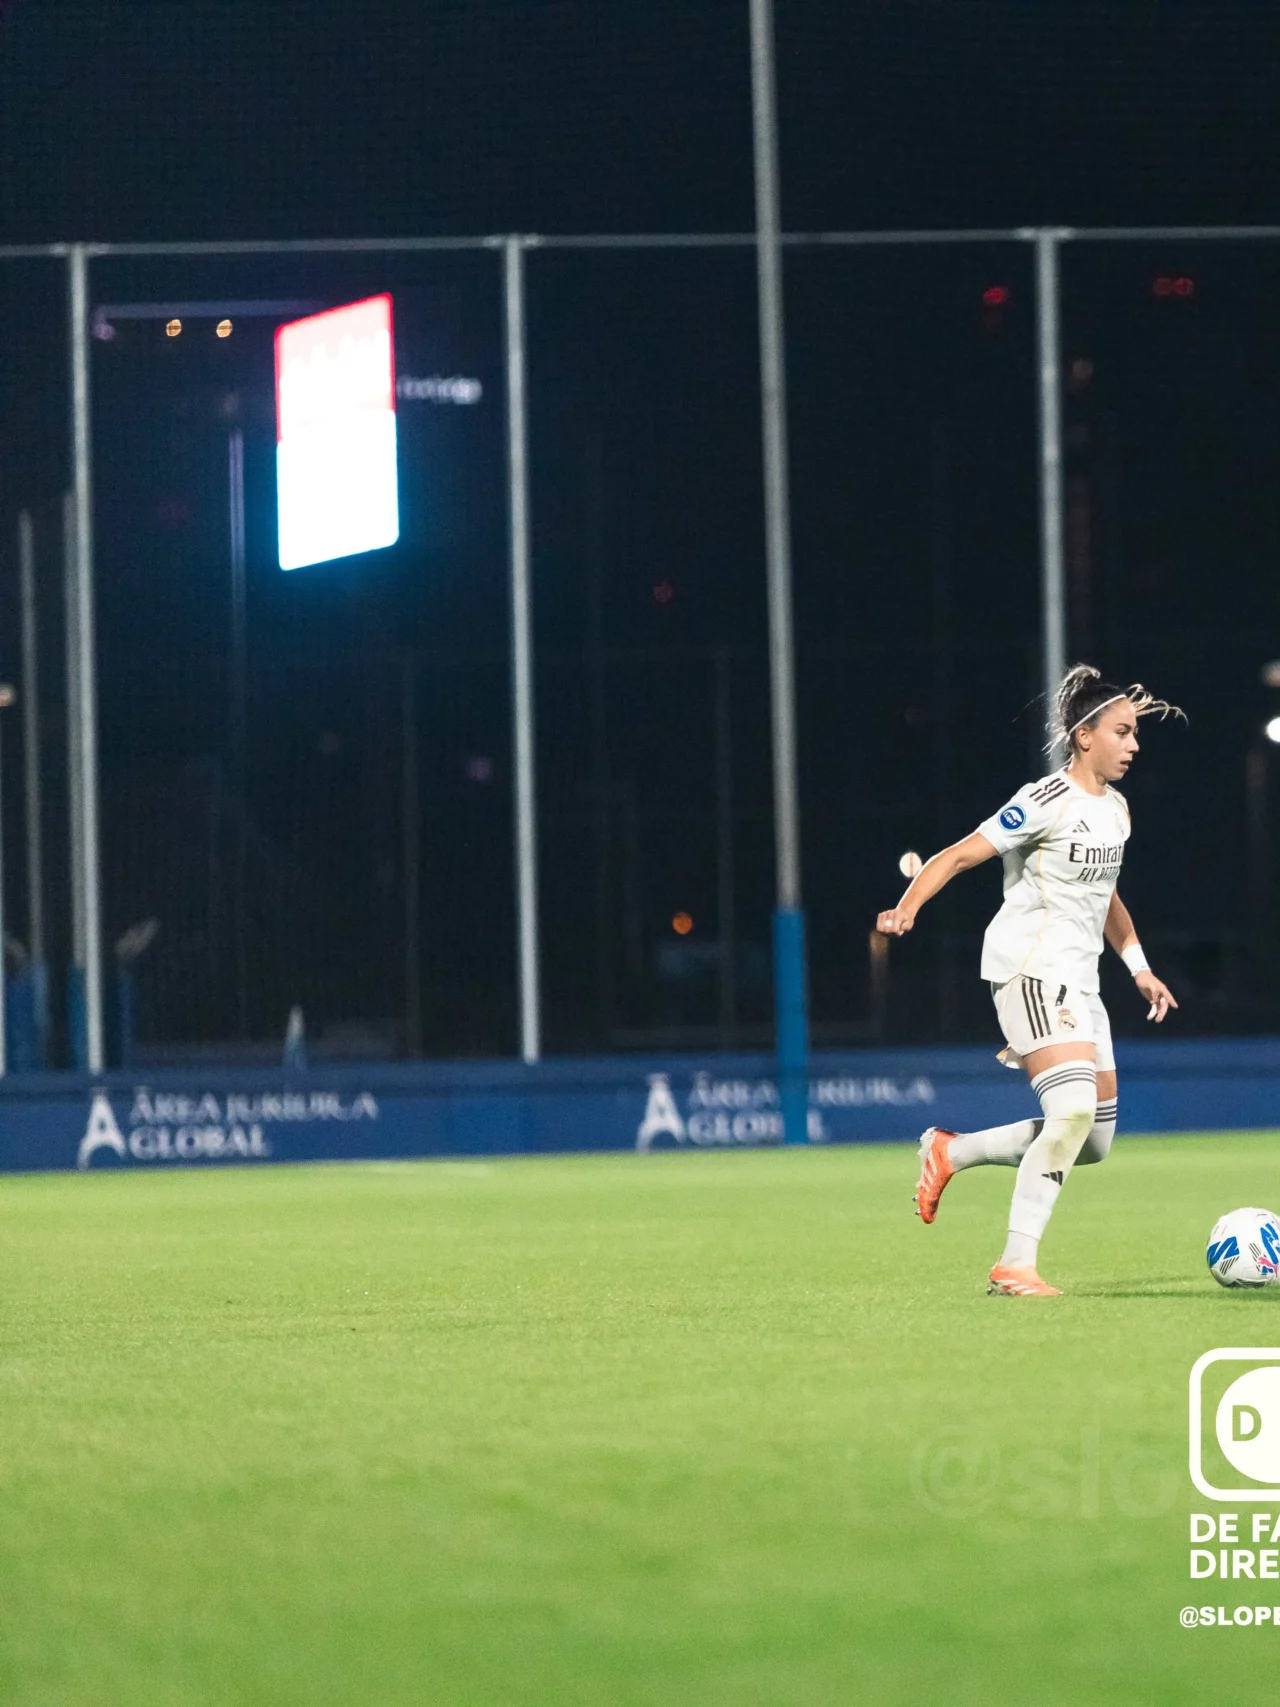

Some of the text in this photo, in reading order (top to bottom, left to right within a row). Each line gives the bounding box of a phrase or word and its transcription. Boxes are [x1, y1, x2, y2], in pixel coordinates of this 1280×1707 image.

[1069, 842, 1122, 864] Emirat
[129, 1123, 270, 1160] GLOBAL
[688, 1108, 832, 1145] GLOBL
